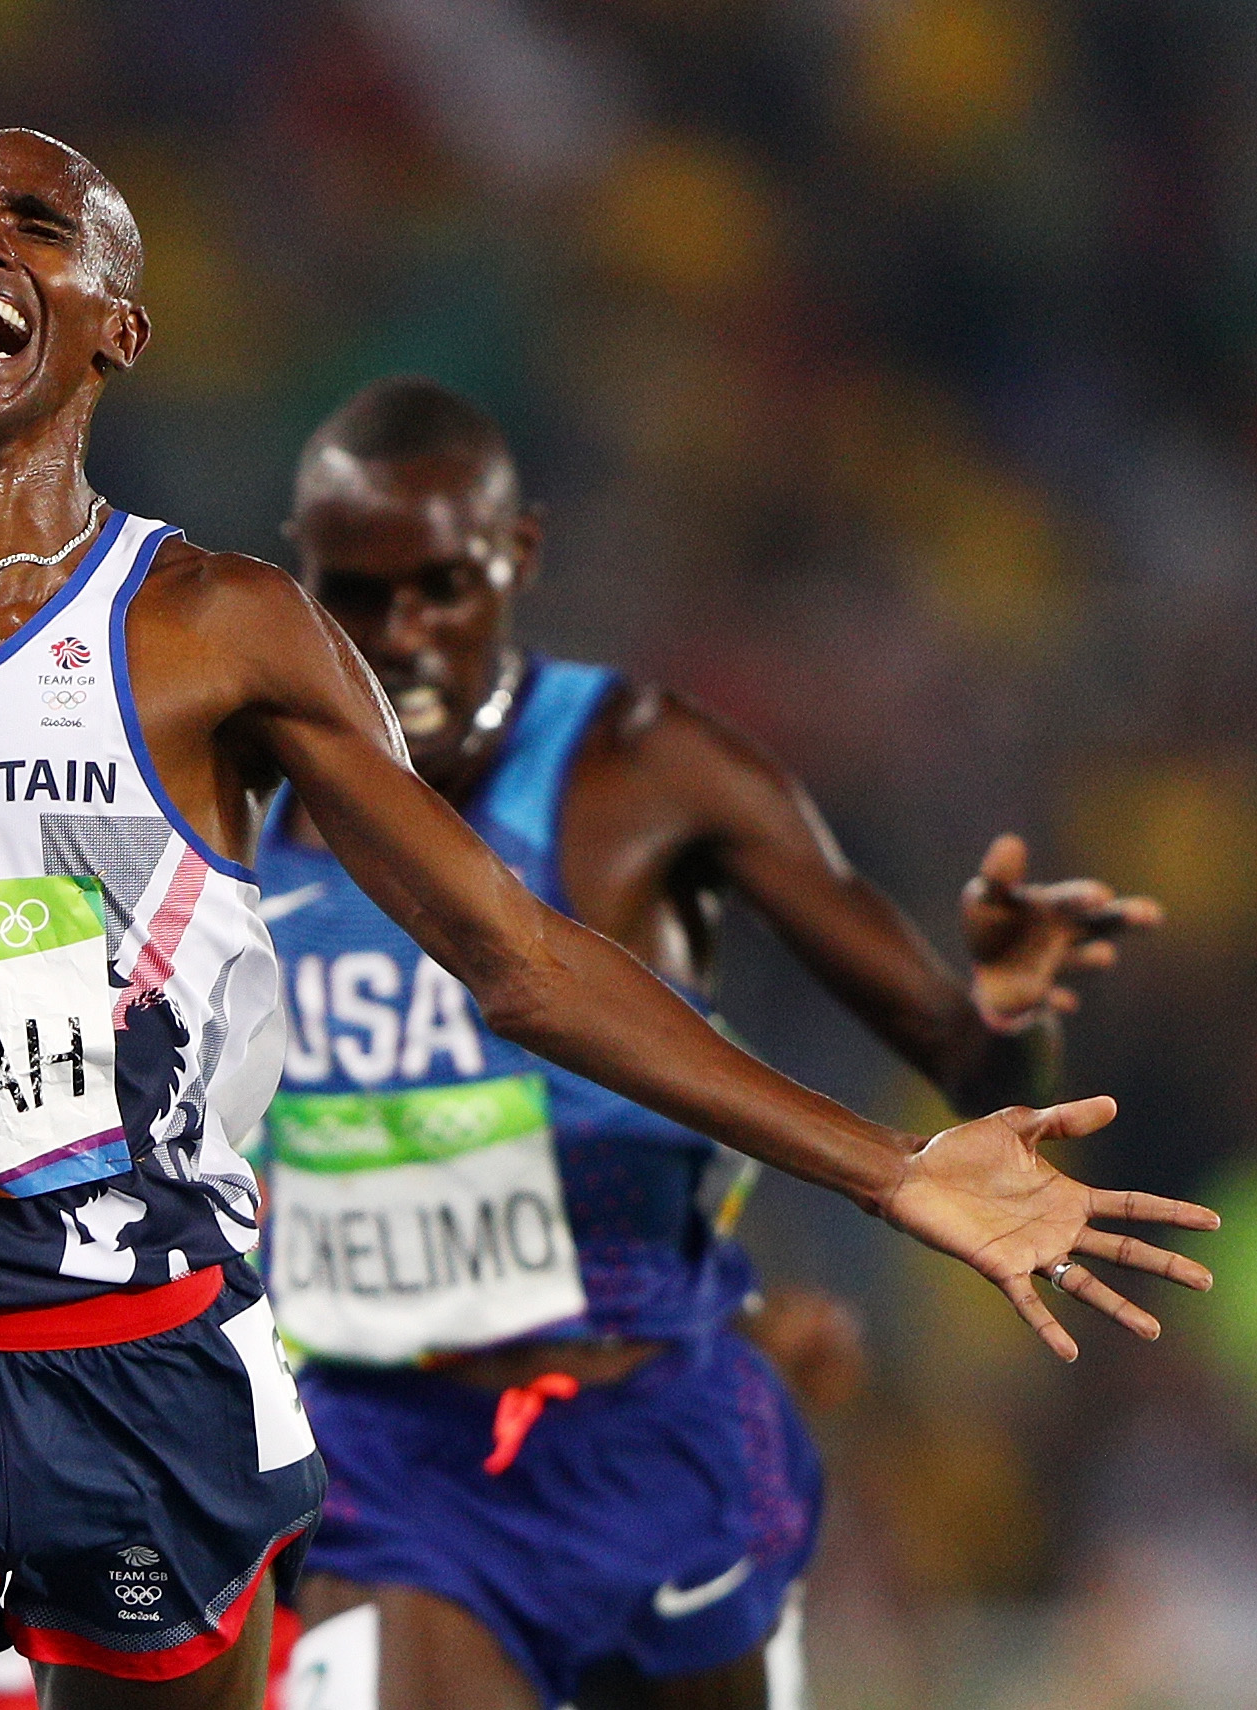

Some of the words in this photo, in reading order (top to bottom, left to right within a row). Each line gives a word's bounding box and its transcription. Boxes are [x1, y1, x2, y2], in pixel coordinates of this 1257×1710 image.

[38, 675, 73, 686] TEAM
[77, 676, 96, 686] GB
[278, 951, 487, 1085] USA
[108, 1570, 145, 1581] TEAM
[148, 1571, 169, 1582] GB
